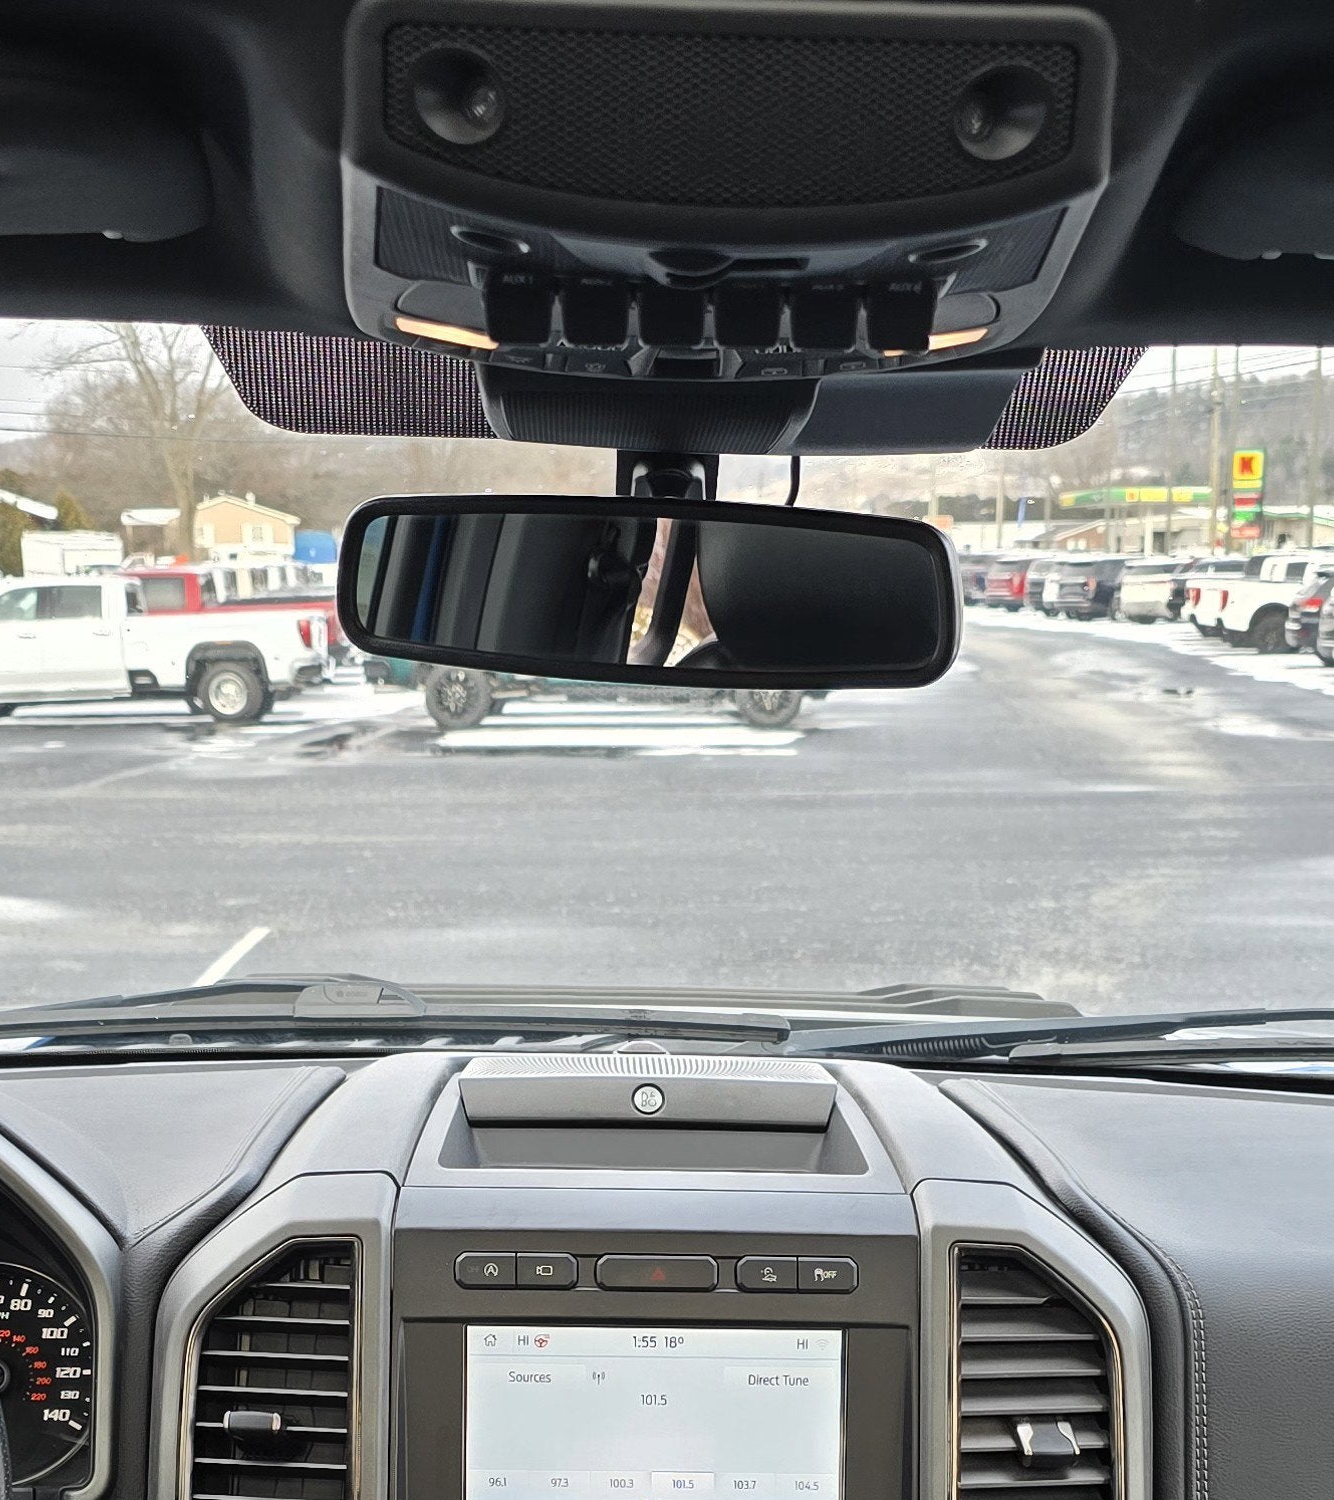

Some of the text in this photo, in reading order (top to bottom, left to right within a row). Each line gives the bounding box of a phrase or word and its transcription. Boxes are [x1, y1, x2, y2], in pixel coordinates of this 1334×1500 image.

[10, 1299, 32, 1311] 80
[37, 1309, 54, 1318] 90
[41, 1328, 67, 1339] 100
[517, 1335, 529, 1346] HI
[633, 1336, 657, 1348] 1:55
[796, 1339, 809, 1350] HI
[61, 1348, 79, 1356] 110
[55, 1367, 81, 1378] 120
[508, 1371, 552, 1383] Sources
[748, 1374, 809, 1387] Direct Tune
[60, 1390, 79, 1399] 130
[641, 1395, 667, 1406] 101.5
[43, 1409, 70, 1421] 140
[488, 1477, 507, 1487] 96.1
[550, 1478, 569, 1487] 97.3
[609, 1478, 634, 1488] 100.3
[672, 1480, 694, 1489] 101.5
[733, 1480, 756, 1490] 103.7
[795, 1481, 819, 1491] 104.5
